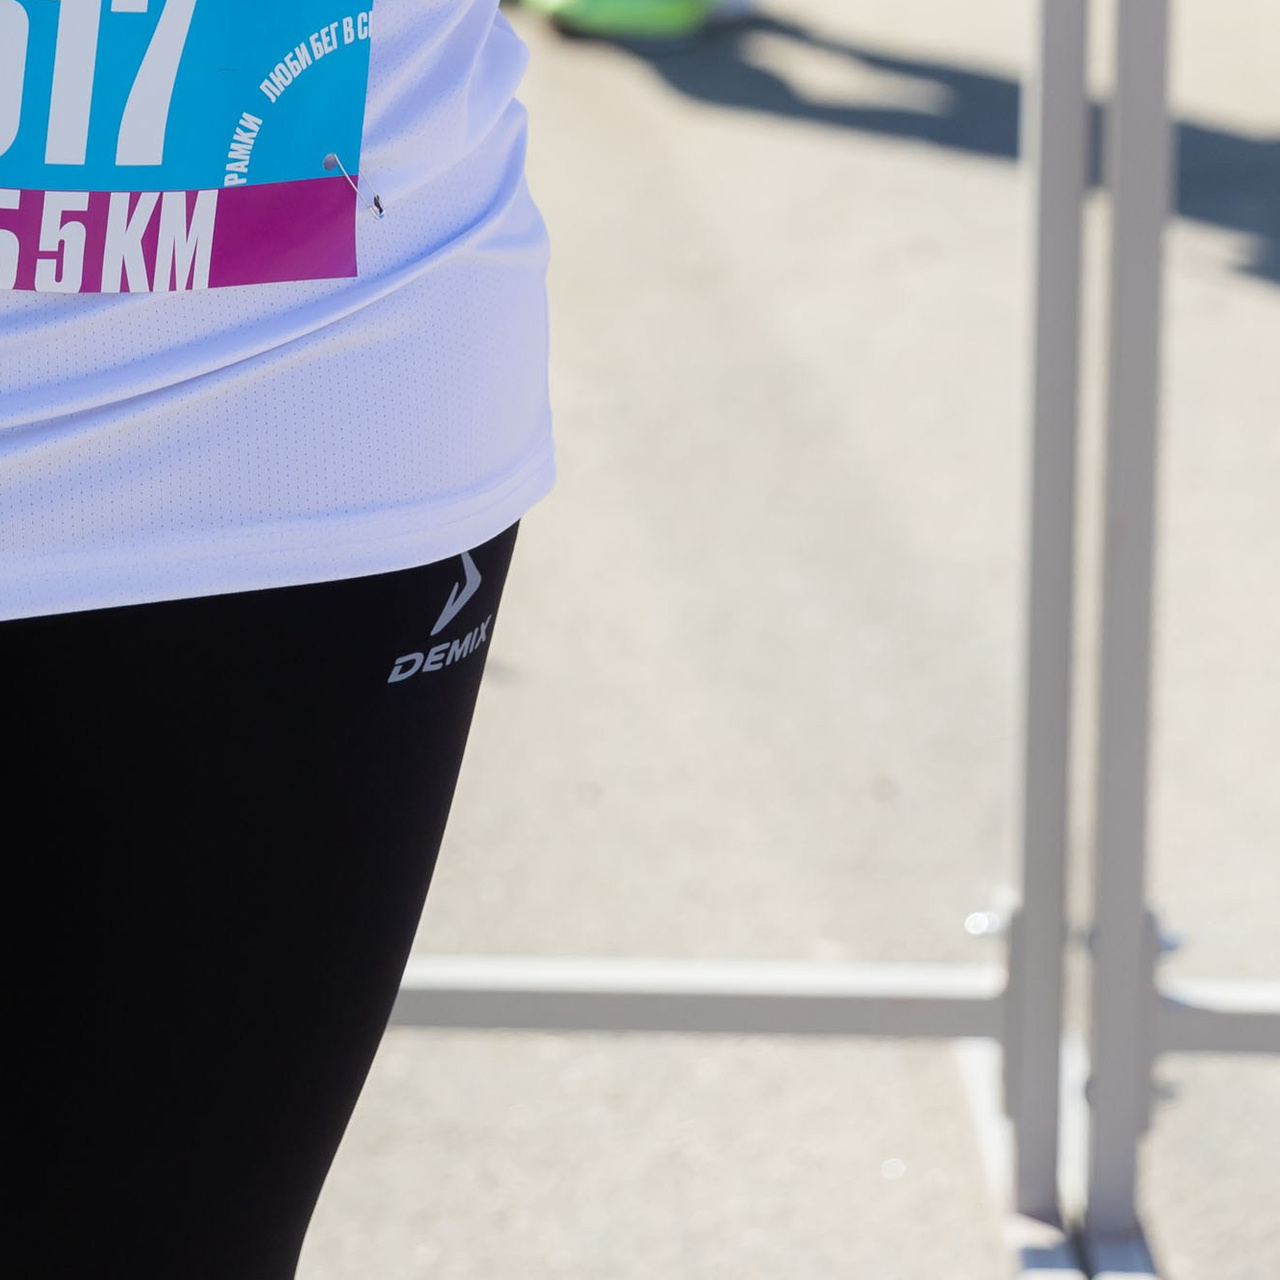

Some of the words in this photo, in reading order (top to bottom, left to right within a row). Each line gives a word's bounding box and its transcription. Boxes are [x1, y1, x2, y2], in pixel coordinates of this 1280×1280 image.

[259, 42, 313, 104] ЛЮБИ
[309, 21, 339, 60] БЕГ
[342, 16, 355, 45] В
[223, 111, 263, 187] РАМКИ
[33, 191, 90, 293] 5
[100, 189, 219, 293] КМ
[387, 613, 493, 684] DEMIX
